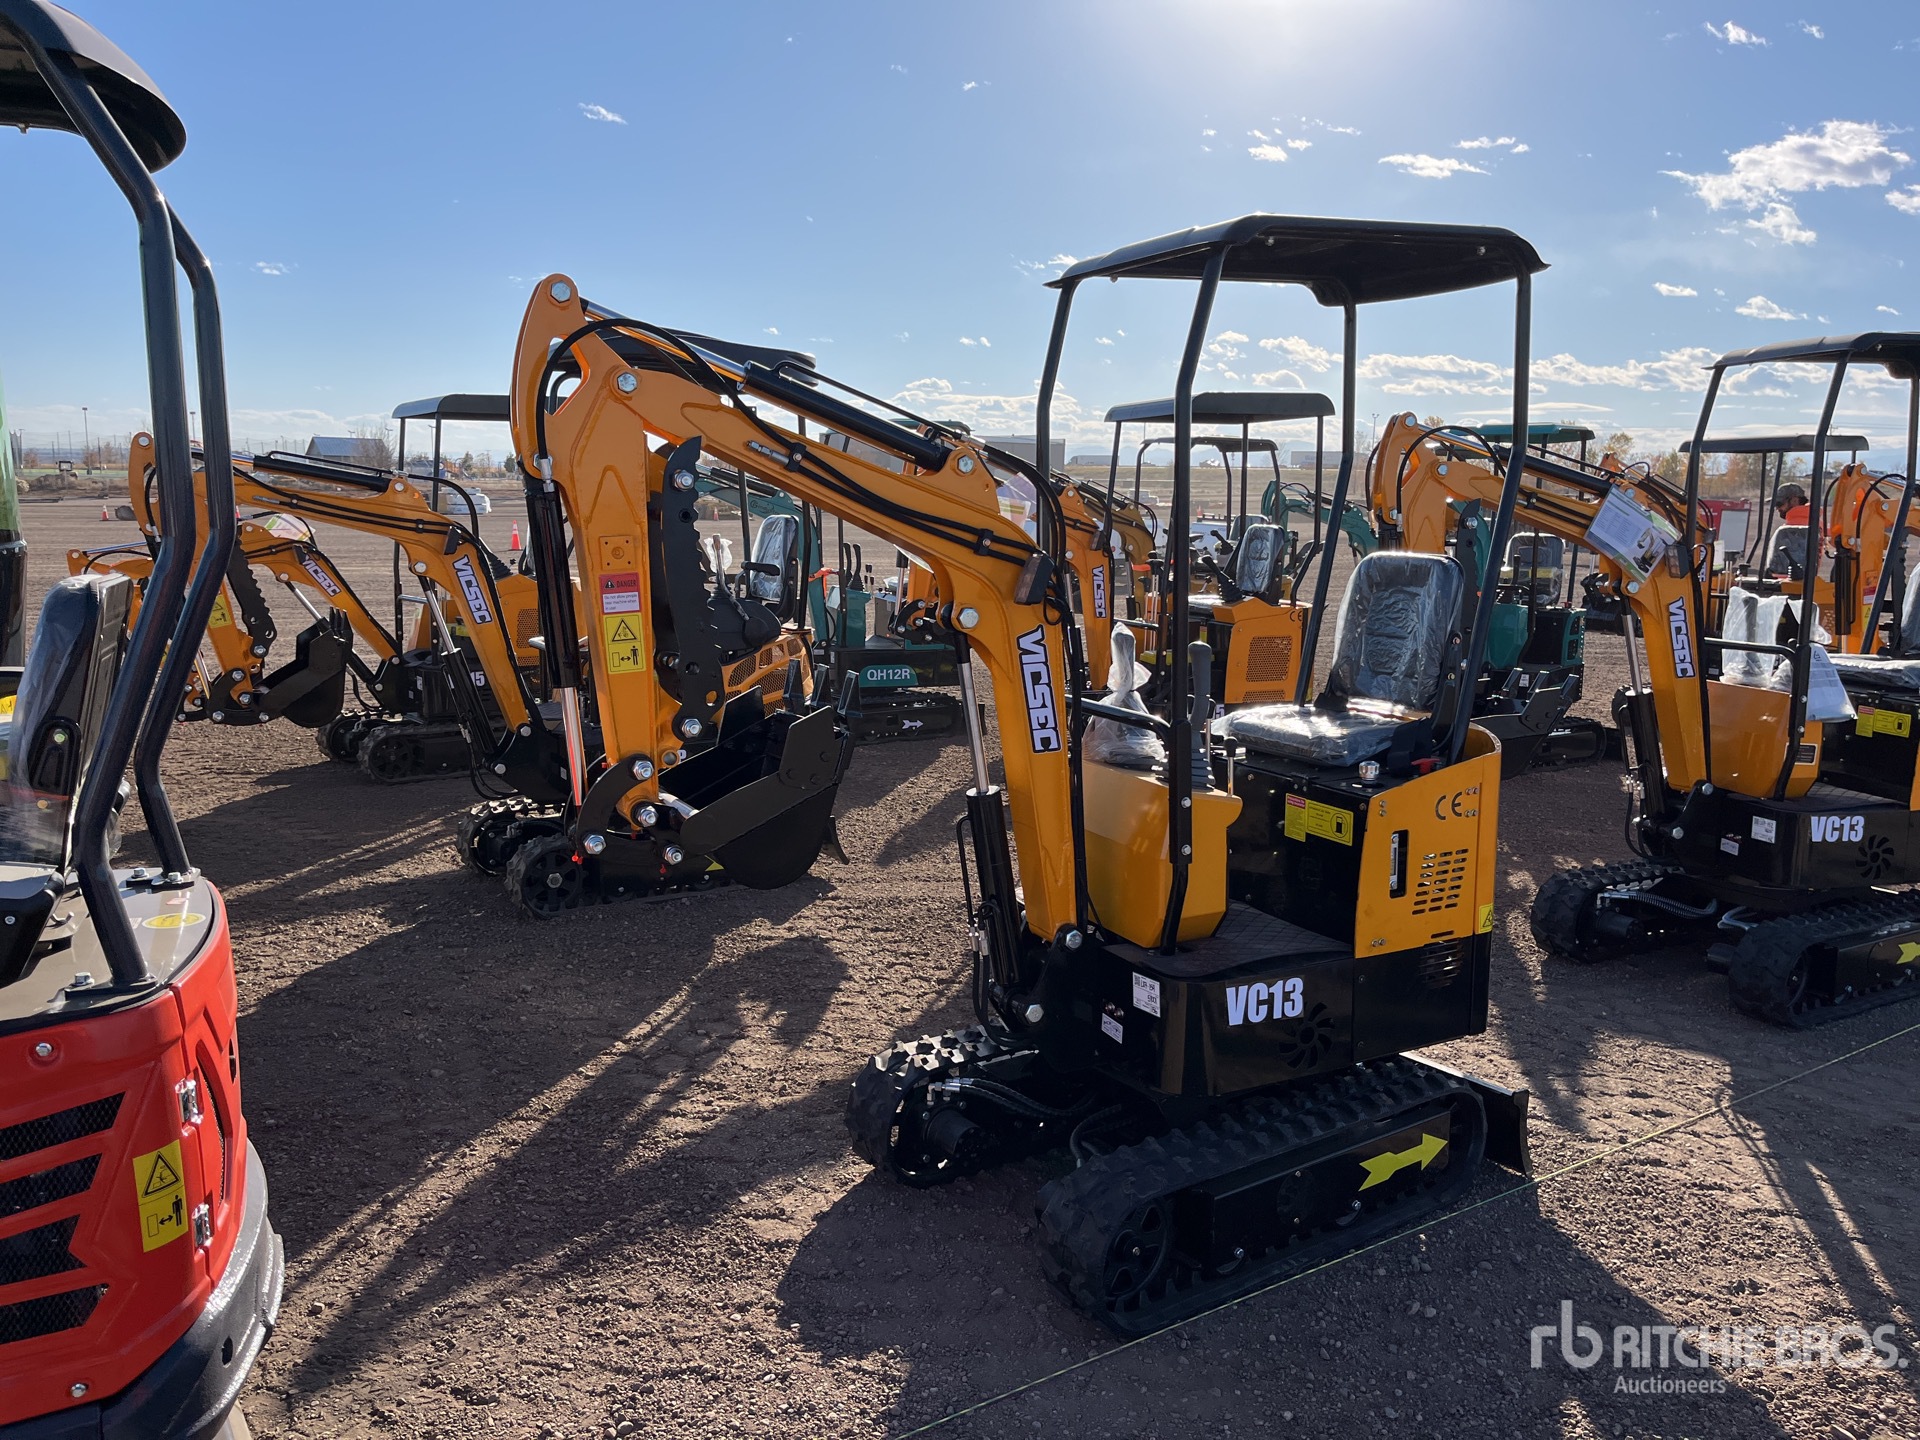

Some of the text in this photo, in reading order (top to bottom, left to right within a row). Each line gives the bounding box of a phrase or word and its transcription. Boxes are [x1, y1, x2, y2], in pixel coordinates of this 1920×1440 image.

[453, 555, 492, 624] VICSEC
[1092, 565, 1106, 618] VICSEC
[1668, 597, 1695, 677] VICSEC
[866, 668, 911, 681] QH12R
[1018, 625, 1060, 752] VICSEC
[1810, 815, 1865, 842] VC13
[1225, 977, 1304, 1026] VC13
